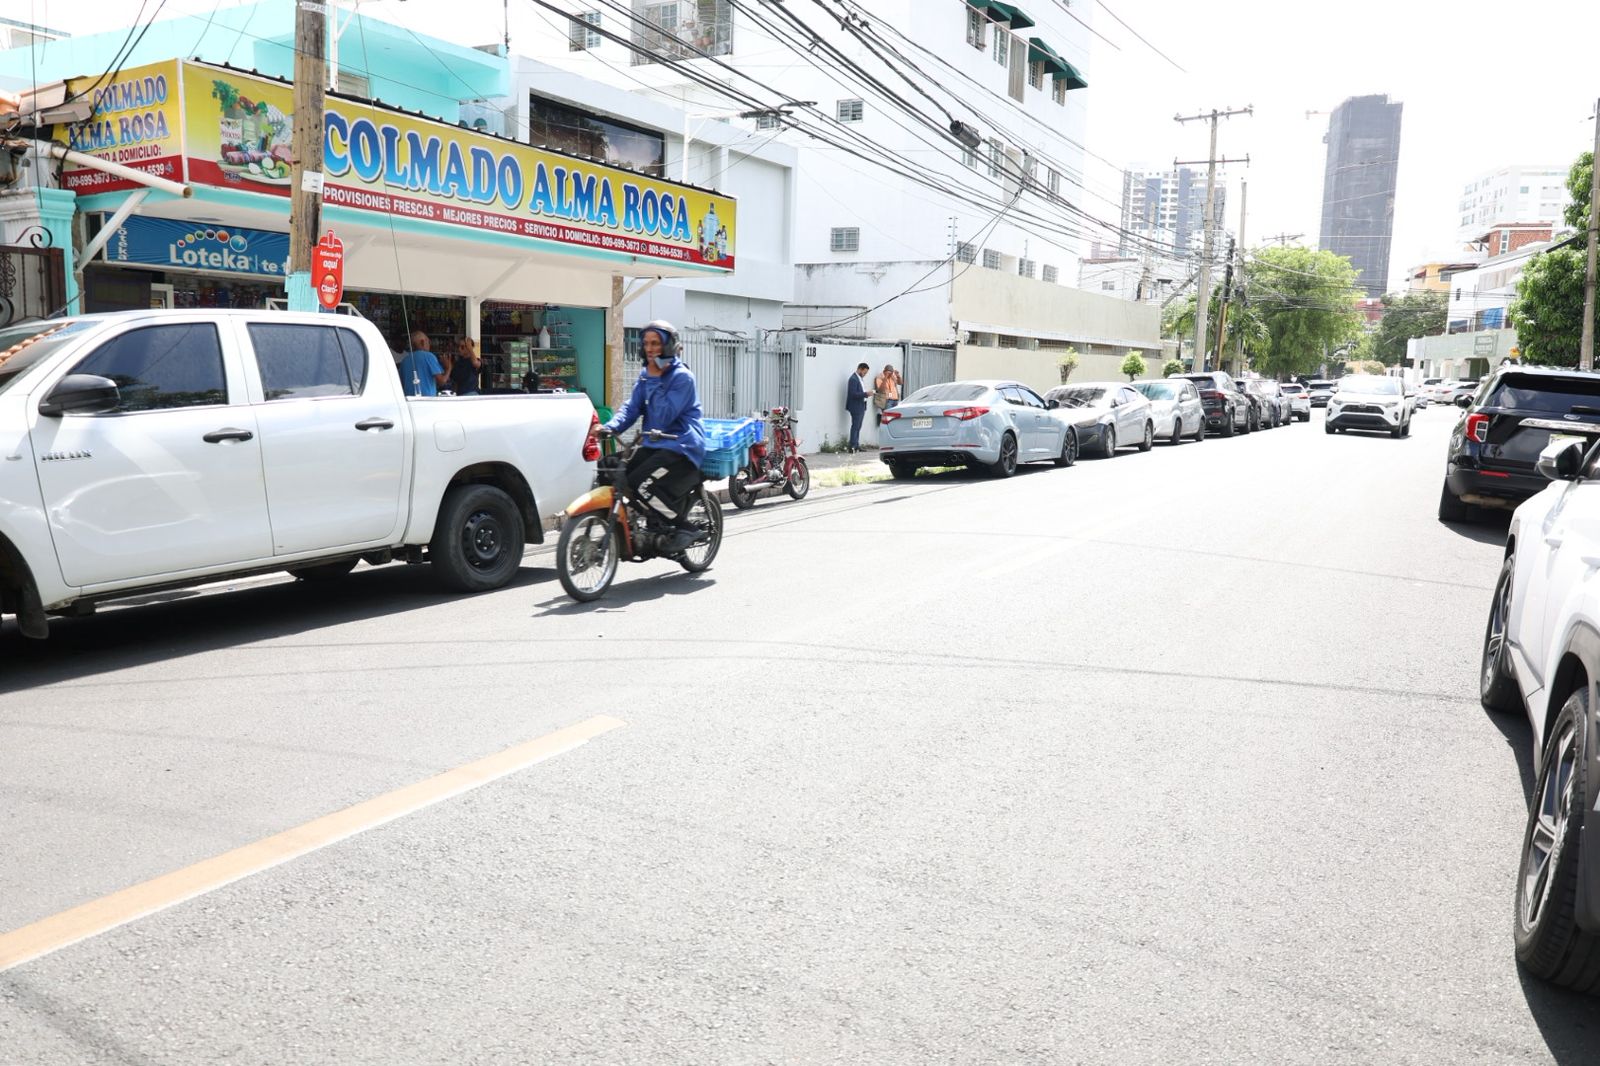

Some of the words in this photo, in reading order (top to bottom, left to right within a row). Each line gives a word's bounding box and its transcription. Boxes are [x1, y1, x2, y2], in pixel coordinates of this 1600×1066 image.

[93, 74, 168, 115] COLMADO
[68, 119, 117, 151] ALMA
[119, 110, 170, 145] ROSA
[119, 144, 161, 162] DOMICILIO:
[324, 111, 523, 209] COLMADO
[528, 162, 619, 229] ALMA
[622, 183, 692, 242] ROSA
[323, 188, 391, 210] PROVISIONES
[393, 199, 434, 217] FRESCAS
[442, 207, 482, 226] MEJORES
[483, 215, 518, 231] PRECIOS
[524, 222, 558, 238] SERVICIO
[558, 229, 564, 239] A
[565, 231, 601, 245] DOMICILIO:
[601, 235, 640, 251] 809-699-3673
[170, 244, 249, 270] Loteka
[261, 259, 278, 272] te
[322, 259, 339, 271] aquí
[321, 284, 336, 293] Claro
[806, 346, 817, 357] 118
